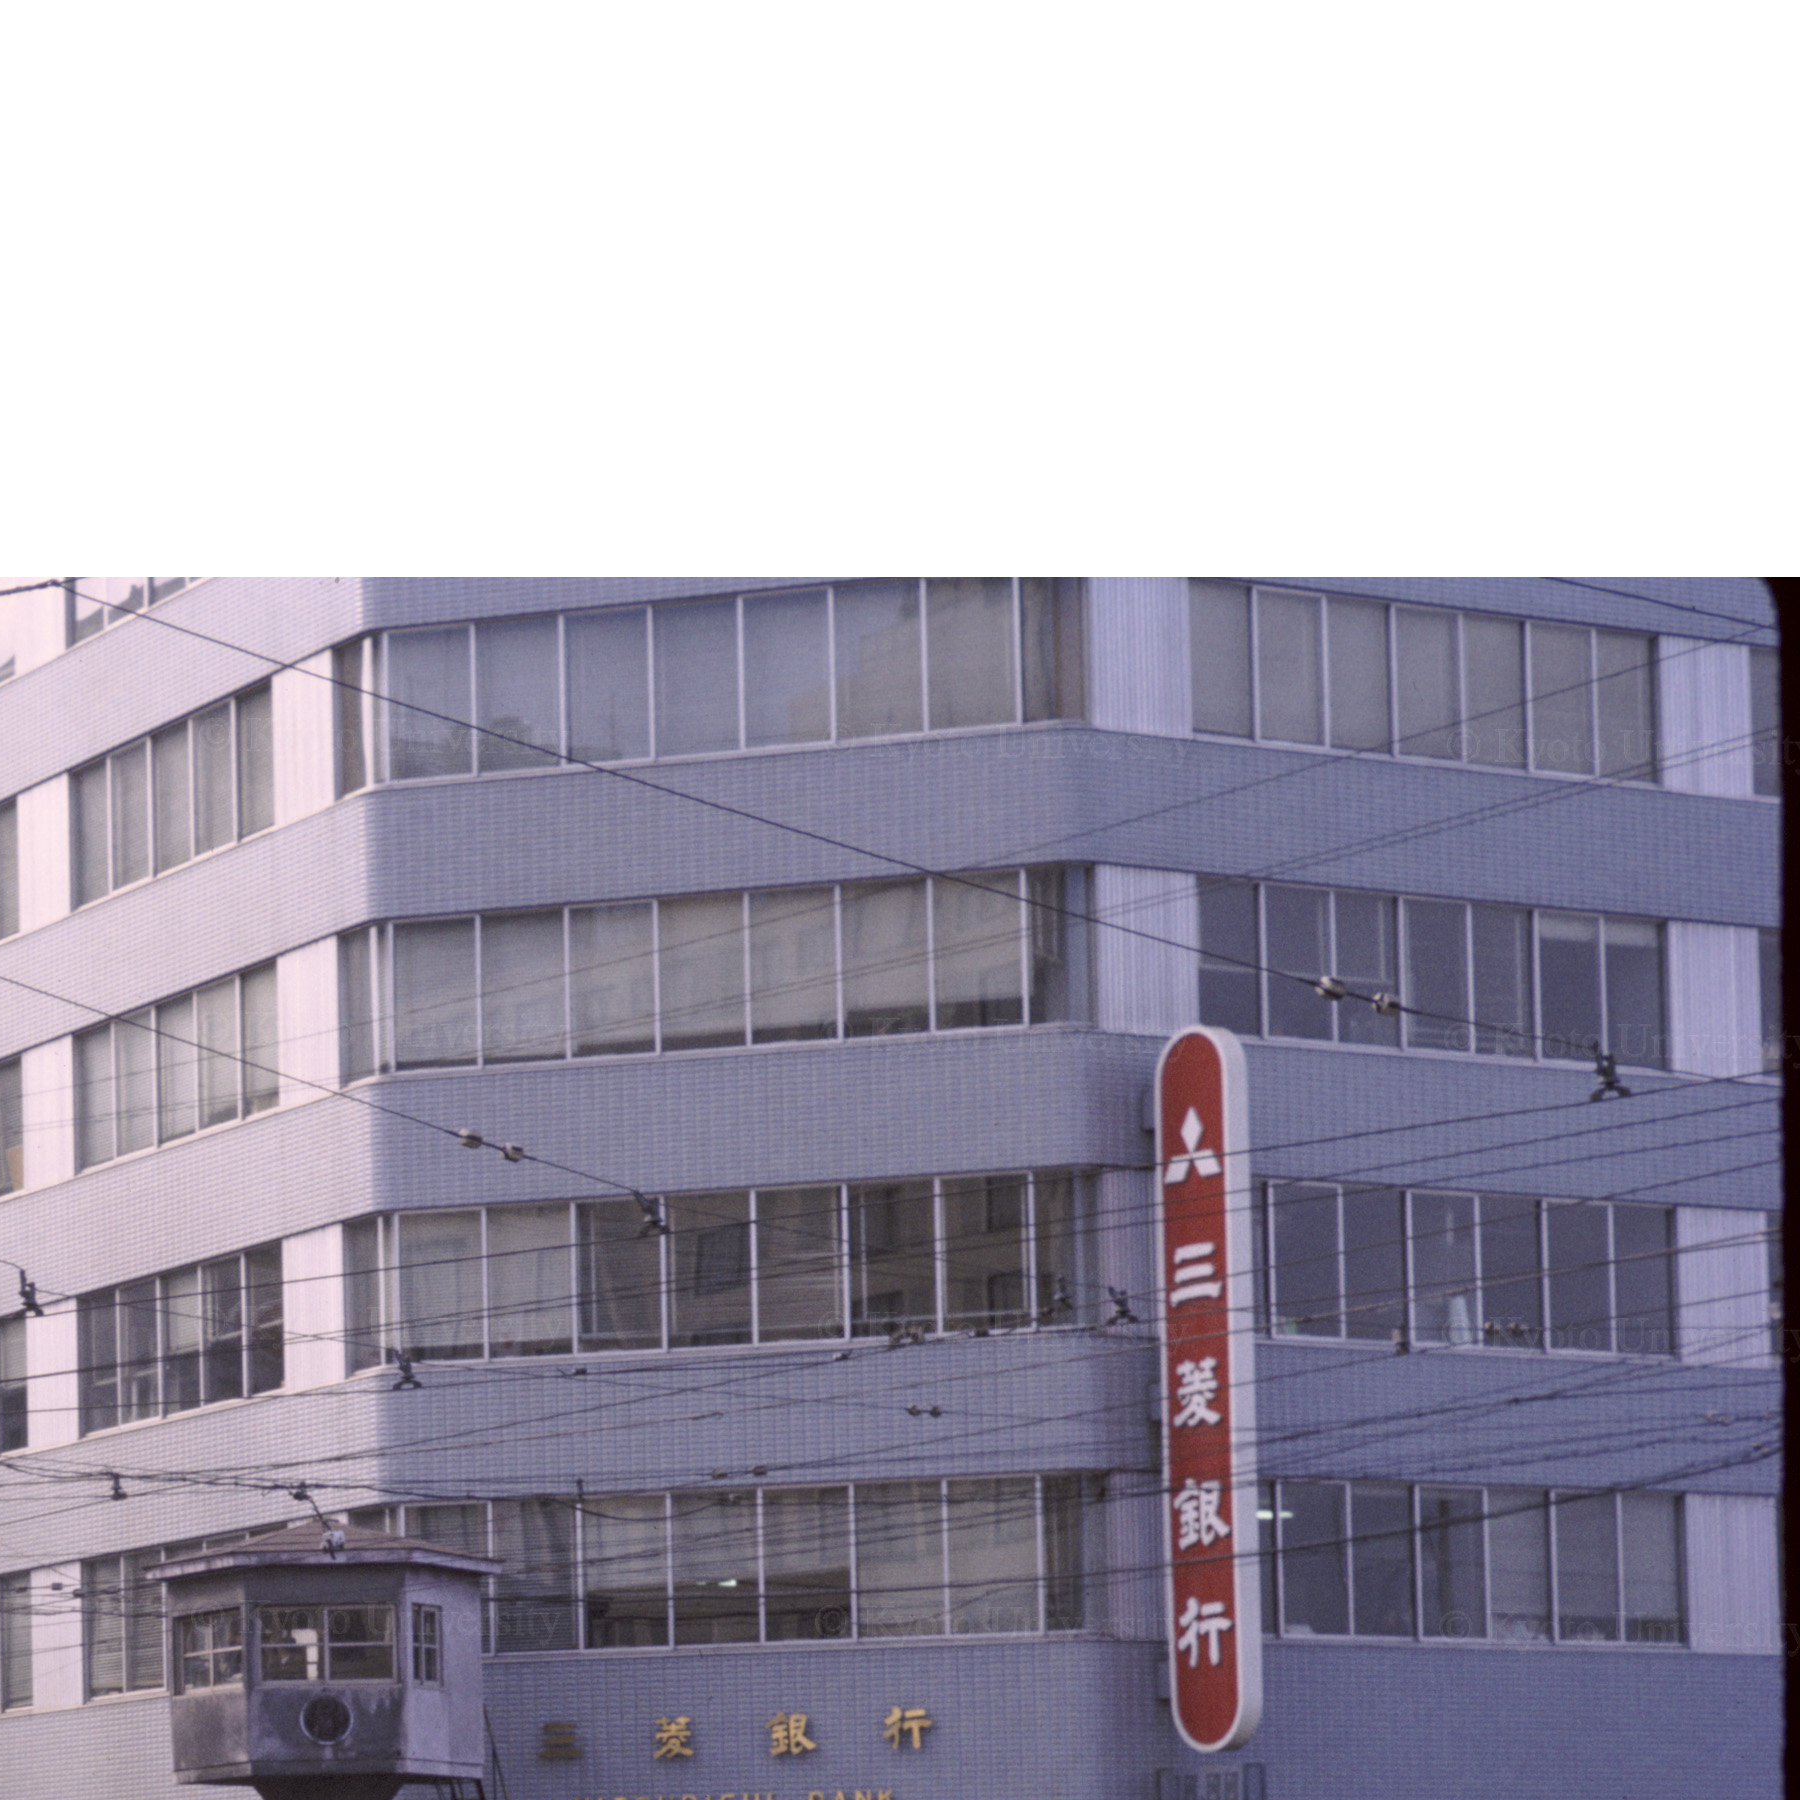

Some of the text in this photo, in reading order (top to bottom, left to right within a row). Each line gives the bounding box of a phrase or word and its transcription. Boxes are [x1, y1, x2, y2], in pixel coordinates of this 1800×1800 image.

[1171, 1242, 1233, 1668] 三菱銀行
[538, 1706, 934, 1761] 三菱銀行
